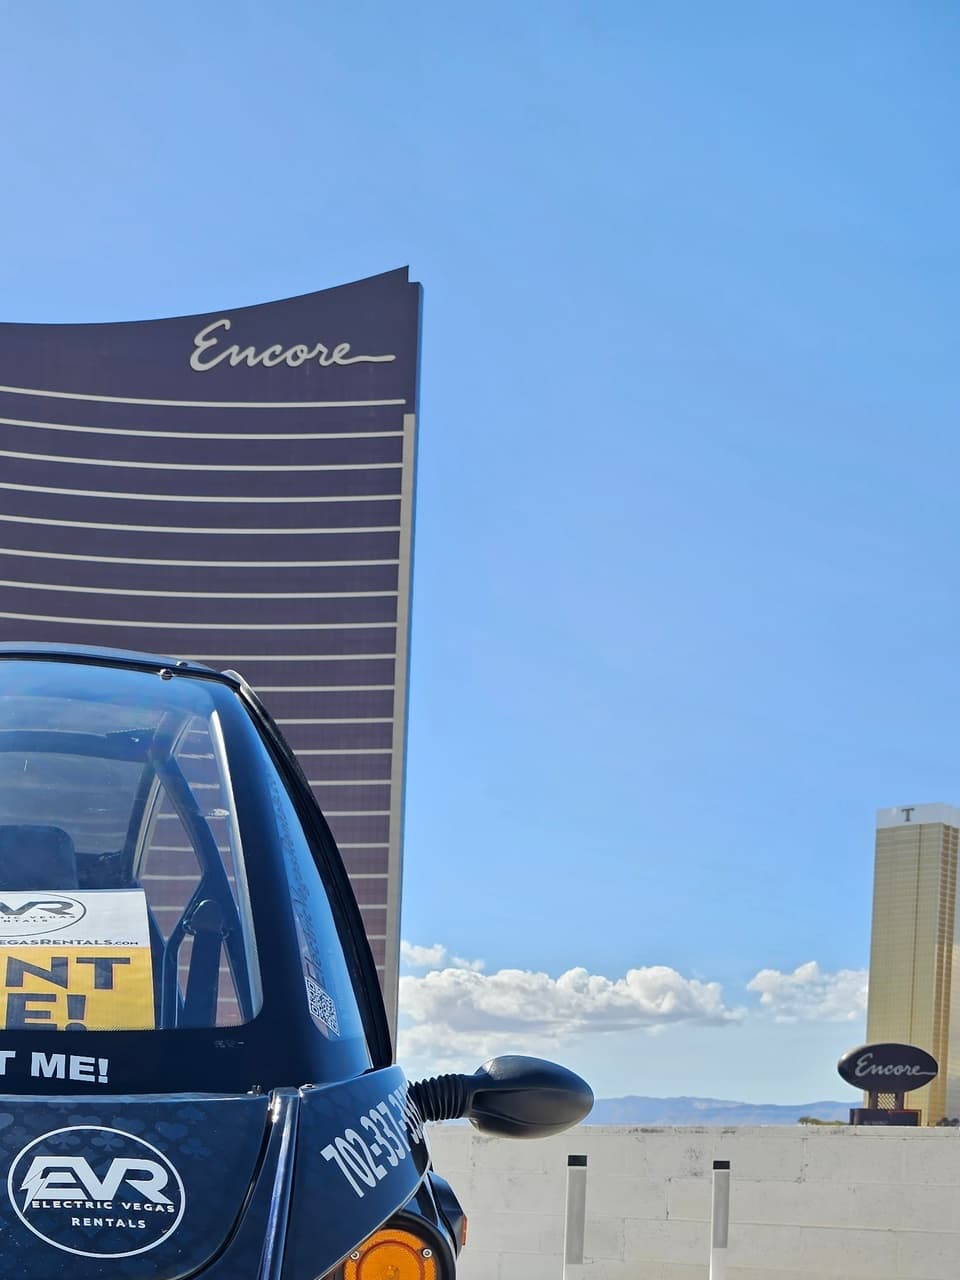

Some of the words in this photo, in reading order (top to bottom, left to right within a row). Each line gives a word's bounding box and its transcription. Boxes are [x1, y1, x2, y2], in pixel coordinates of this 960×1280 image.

[190, 319, 396, 371] Encore
[901, 807, 915, 822] T
[30, 1051, 110, 1084] ME!
[854, 1052, 937, 1077] Encore
[20, 1156, 175, 1206] EVR
[31, 1200, 113, 1210] ELECTRIC
[121, 1202, 176, 1213] VEGAS
[71, 1217, 146, 1229] RENTALS
